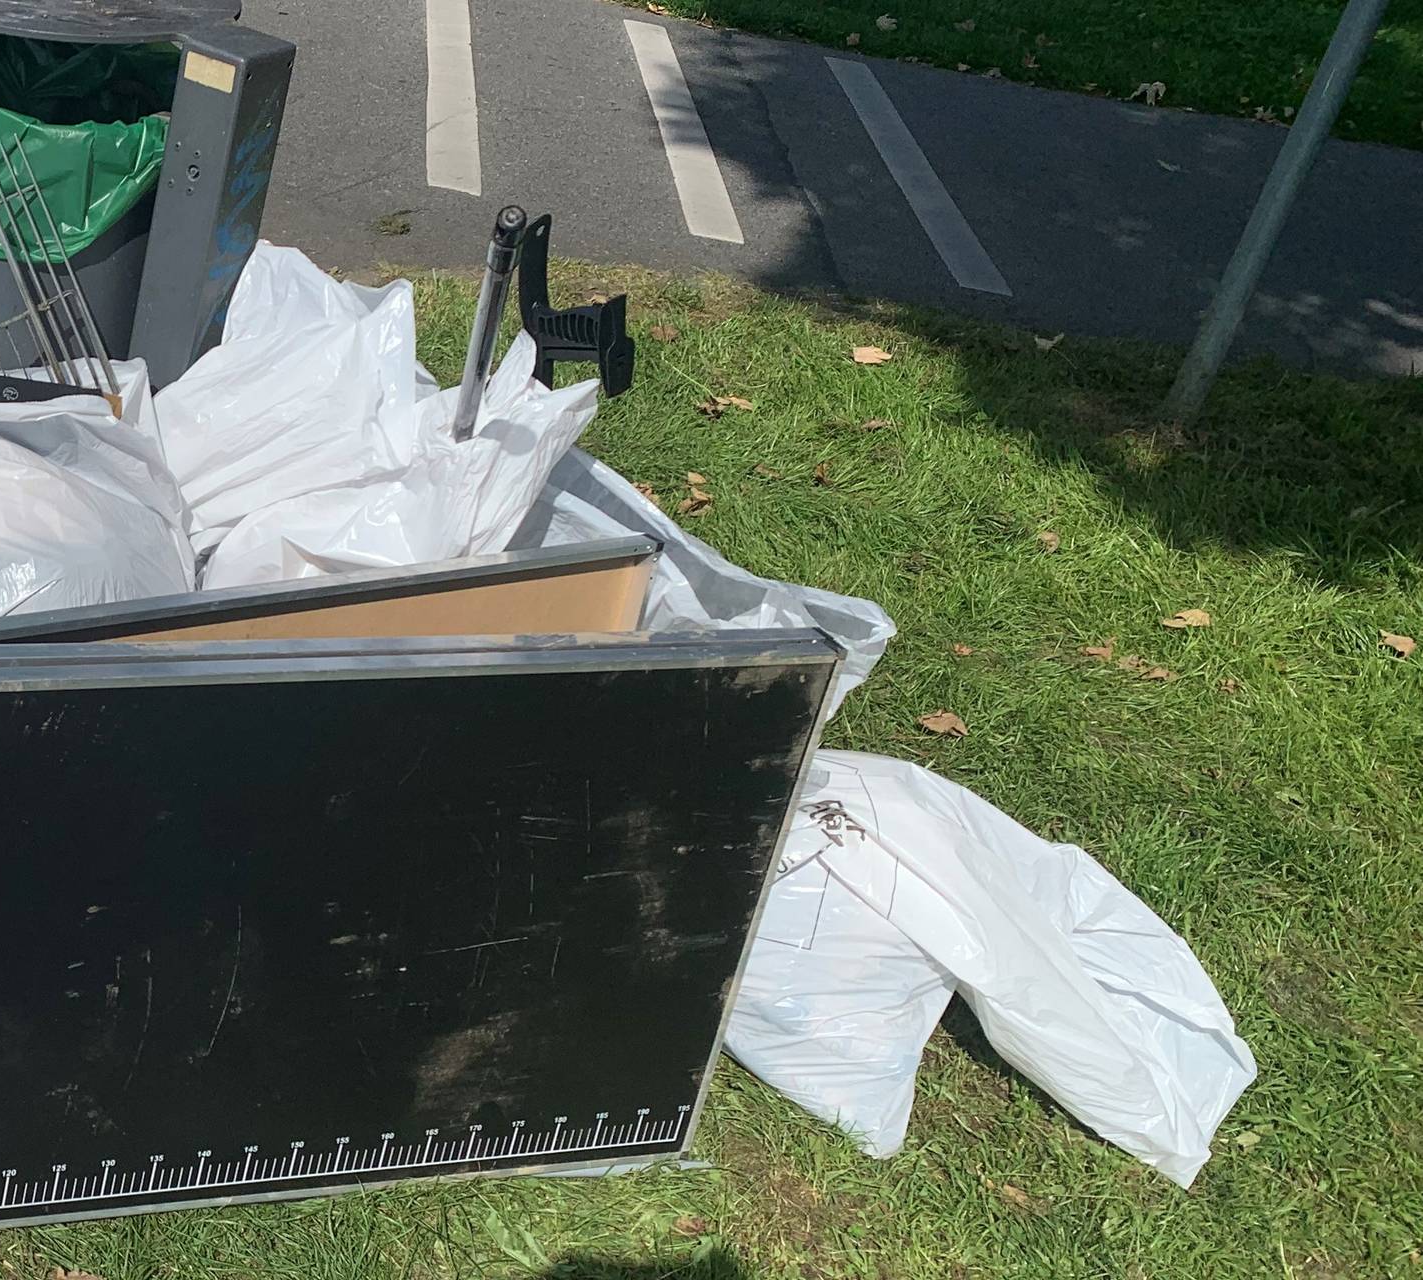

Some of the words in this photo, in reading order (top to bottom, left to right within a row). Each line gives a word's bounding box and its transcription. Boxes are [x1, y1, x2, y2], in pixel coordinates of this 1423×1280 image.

[1, 1169, 17, 1177] 120
[52, 1164, 67, 1172] 125
[101, 1159, 116, 1167] 130
[197, 1150, 212, 1158] 140
[244, 1145, 258, 1153] 145
[290, 1141, 305, 1149] 150
[336, 1136, 350, 1144] 155
[381, 1132, 395, 1140] 160
[425, 1128, 439, 1136] 165
[678, 1104, 691, 1112] 195
